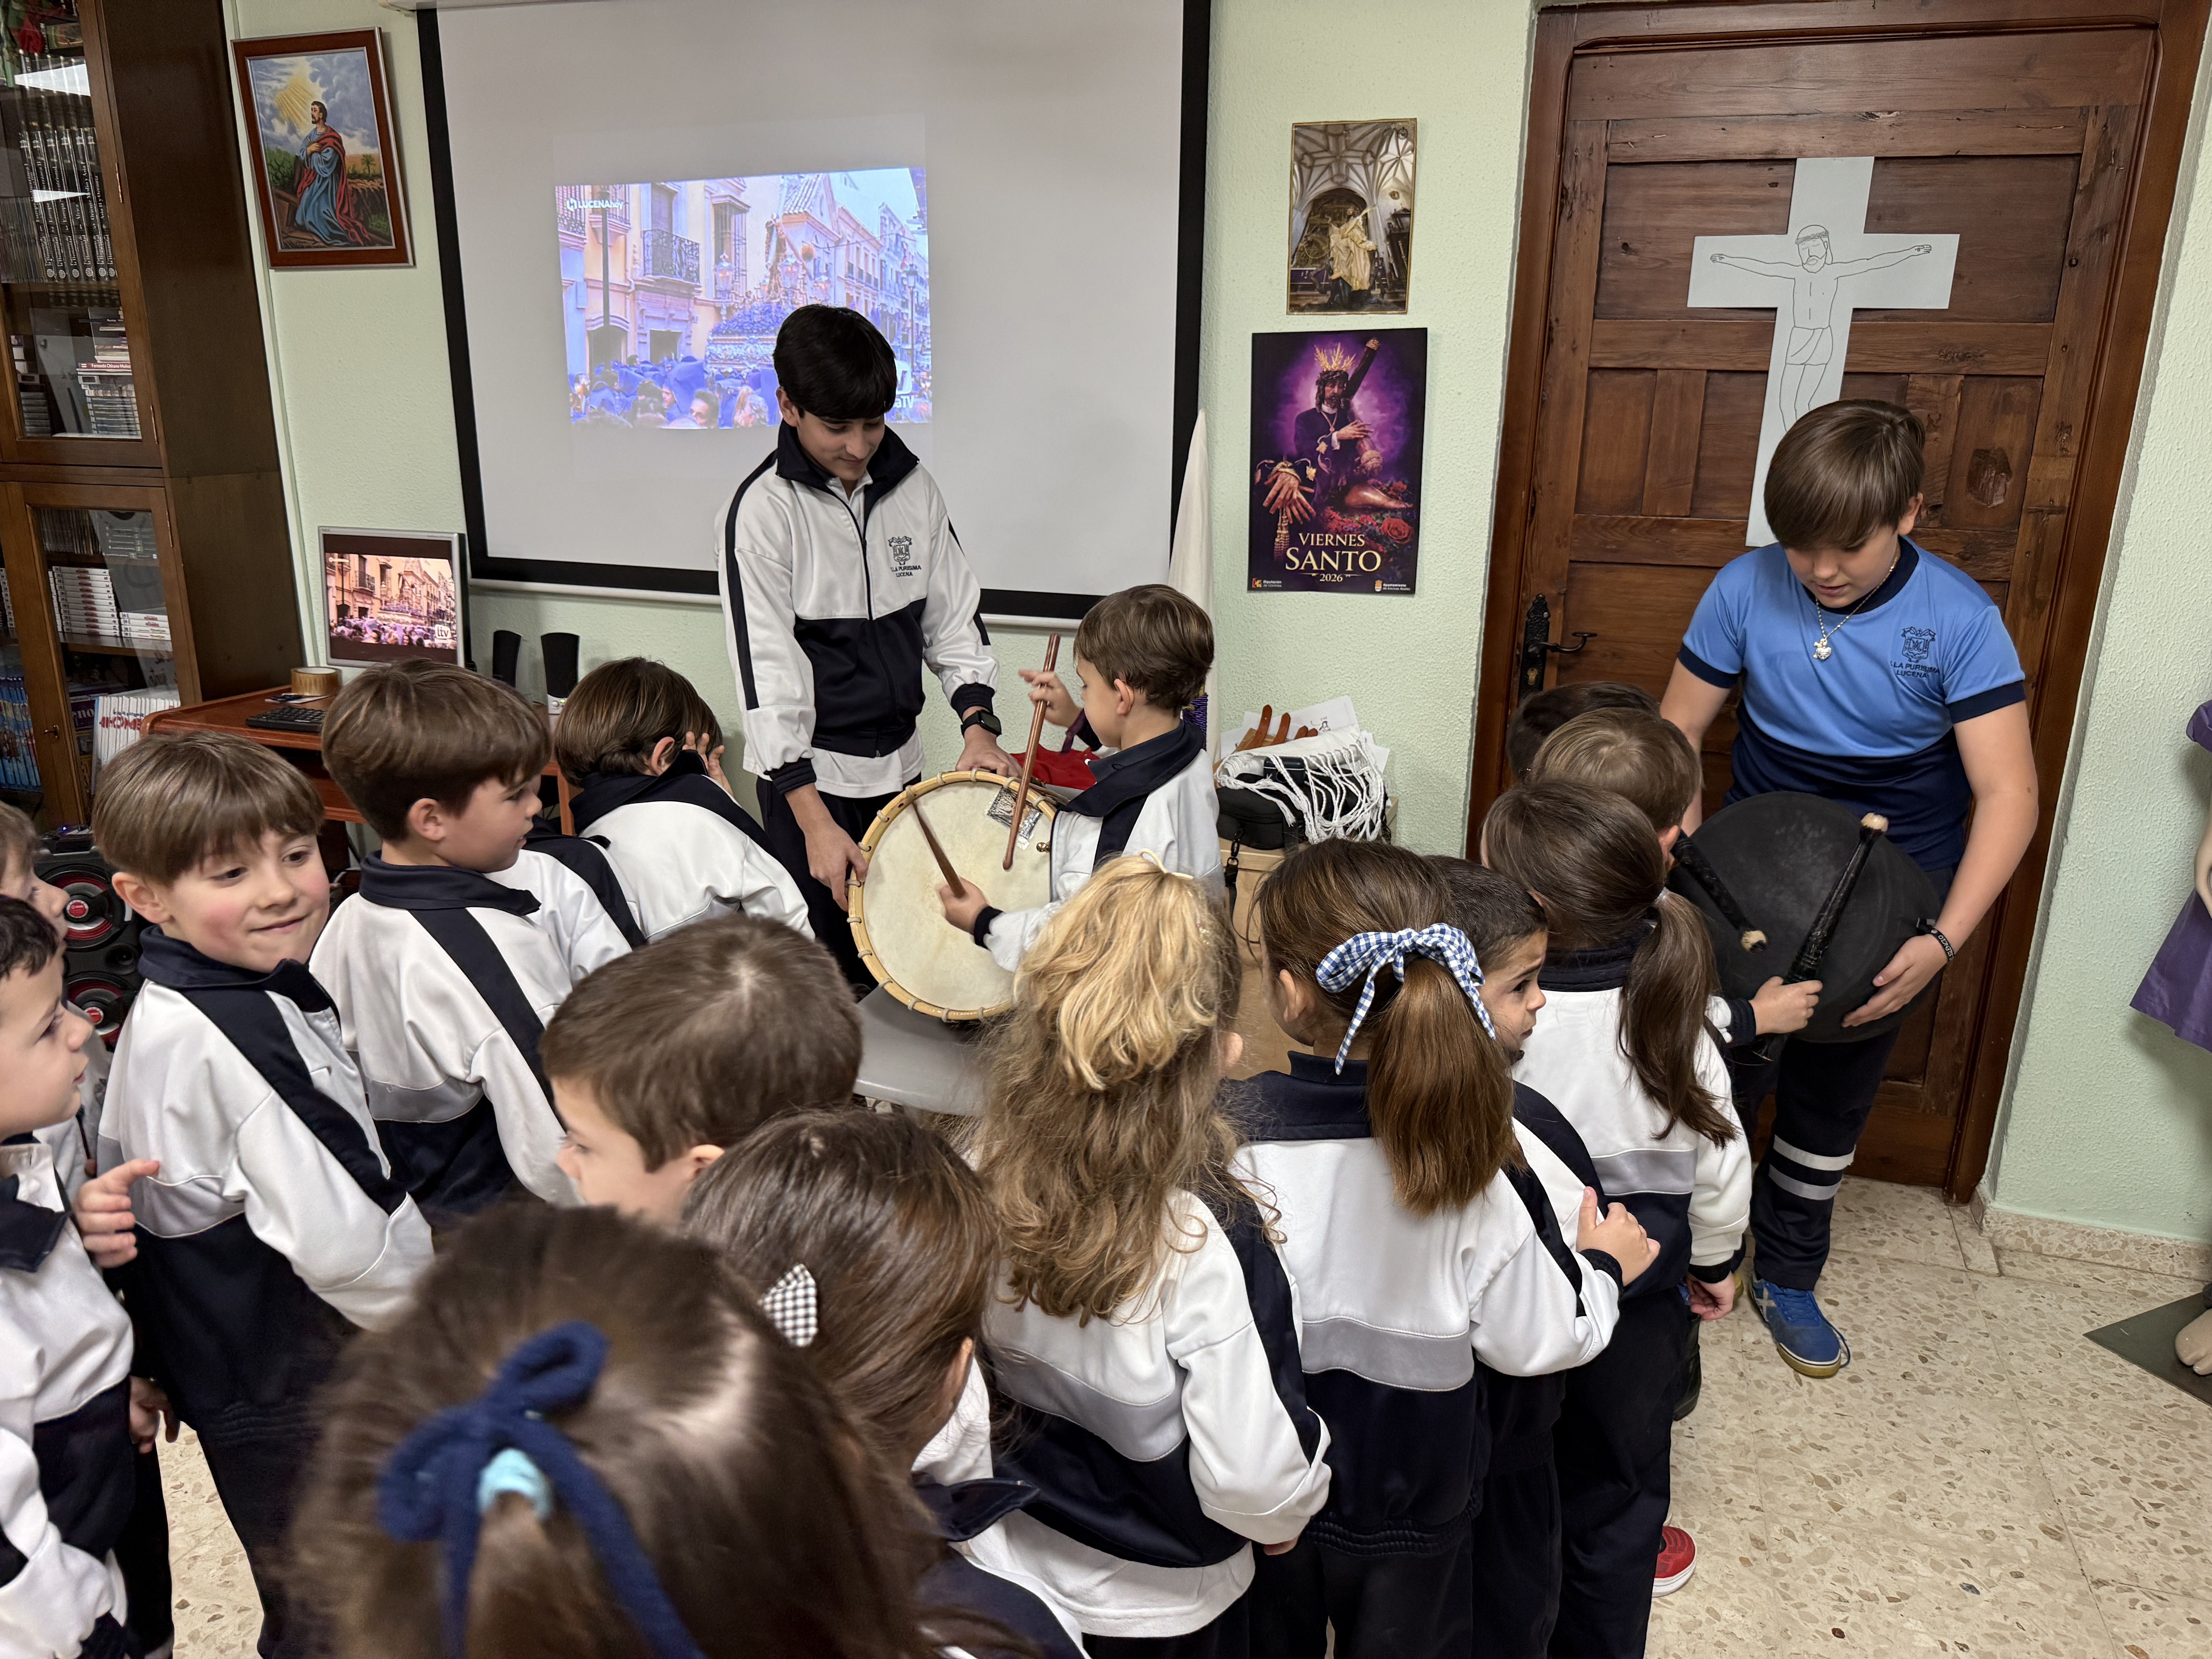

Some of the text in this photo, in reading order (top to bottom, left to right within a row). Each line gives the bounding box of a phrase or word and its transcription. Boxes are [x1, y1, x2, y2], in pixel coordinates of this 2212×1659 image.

[1298, 533, 1365, 546] VIERNES
[1285, 547, 1381, 572] SANTO
[1319, 574, 1343, 582] 2026
[1896, 670, 1928, 678] LUCENA
[1905, 663, 1940, 674] PURISIMA
[1938, 935, 1953, 957] SILENCIO
